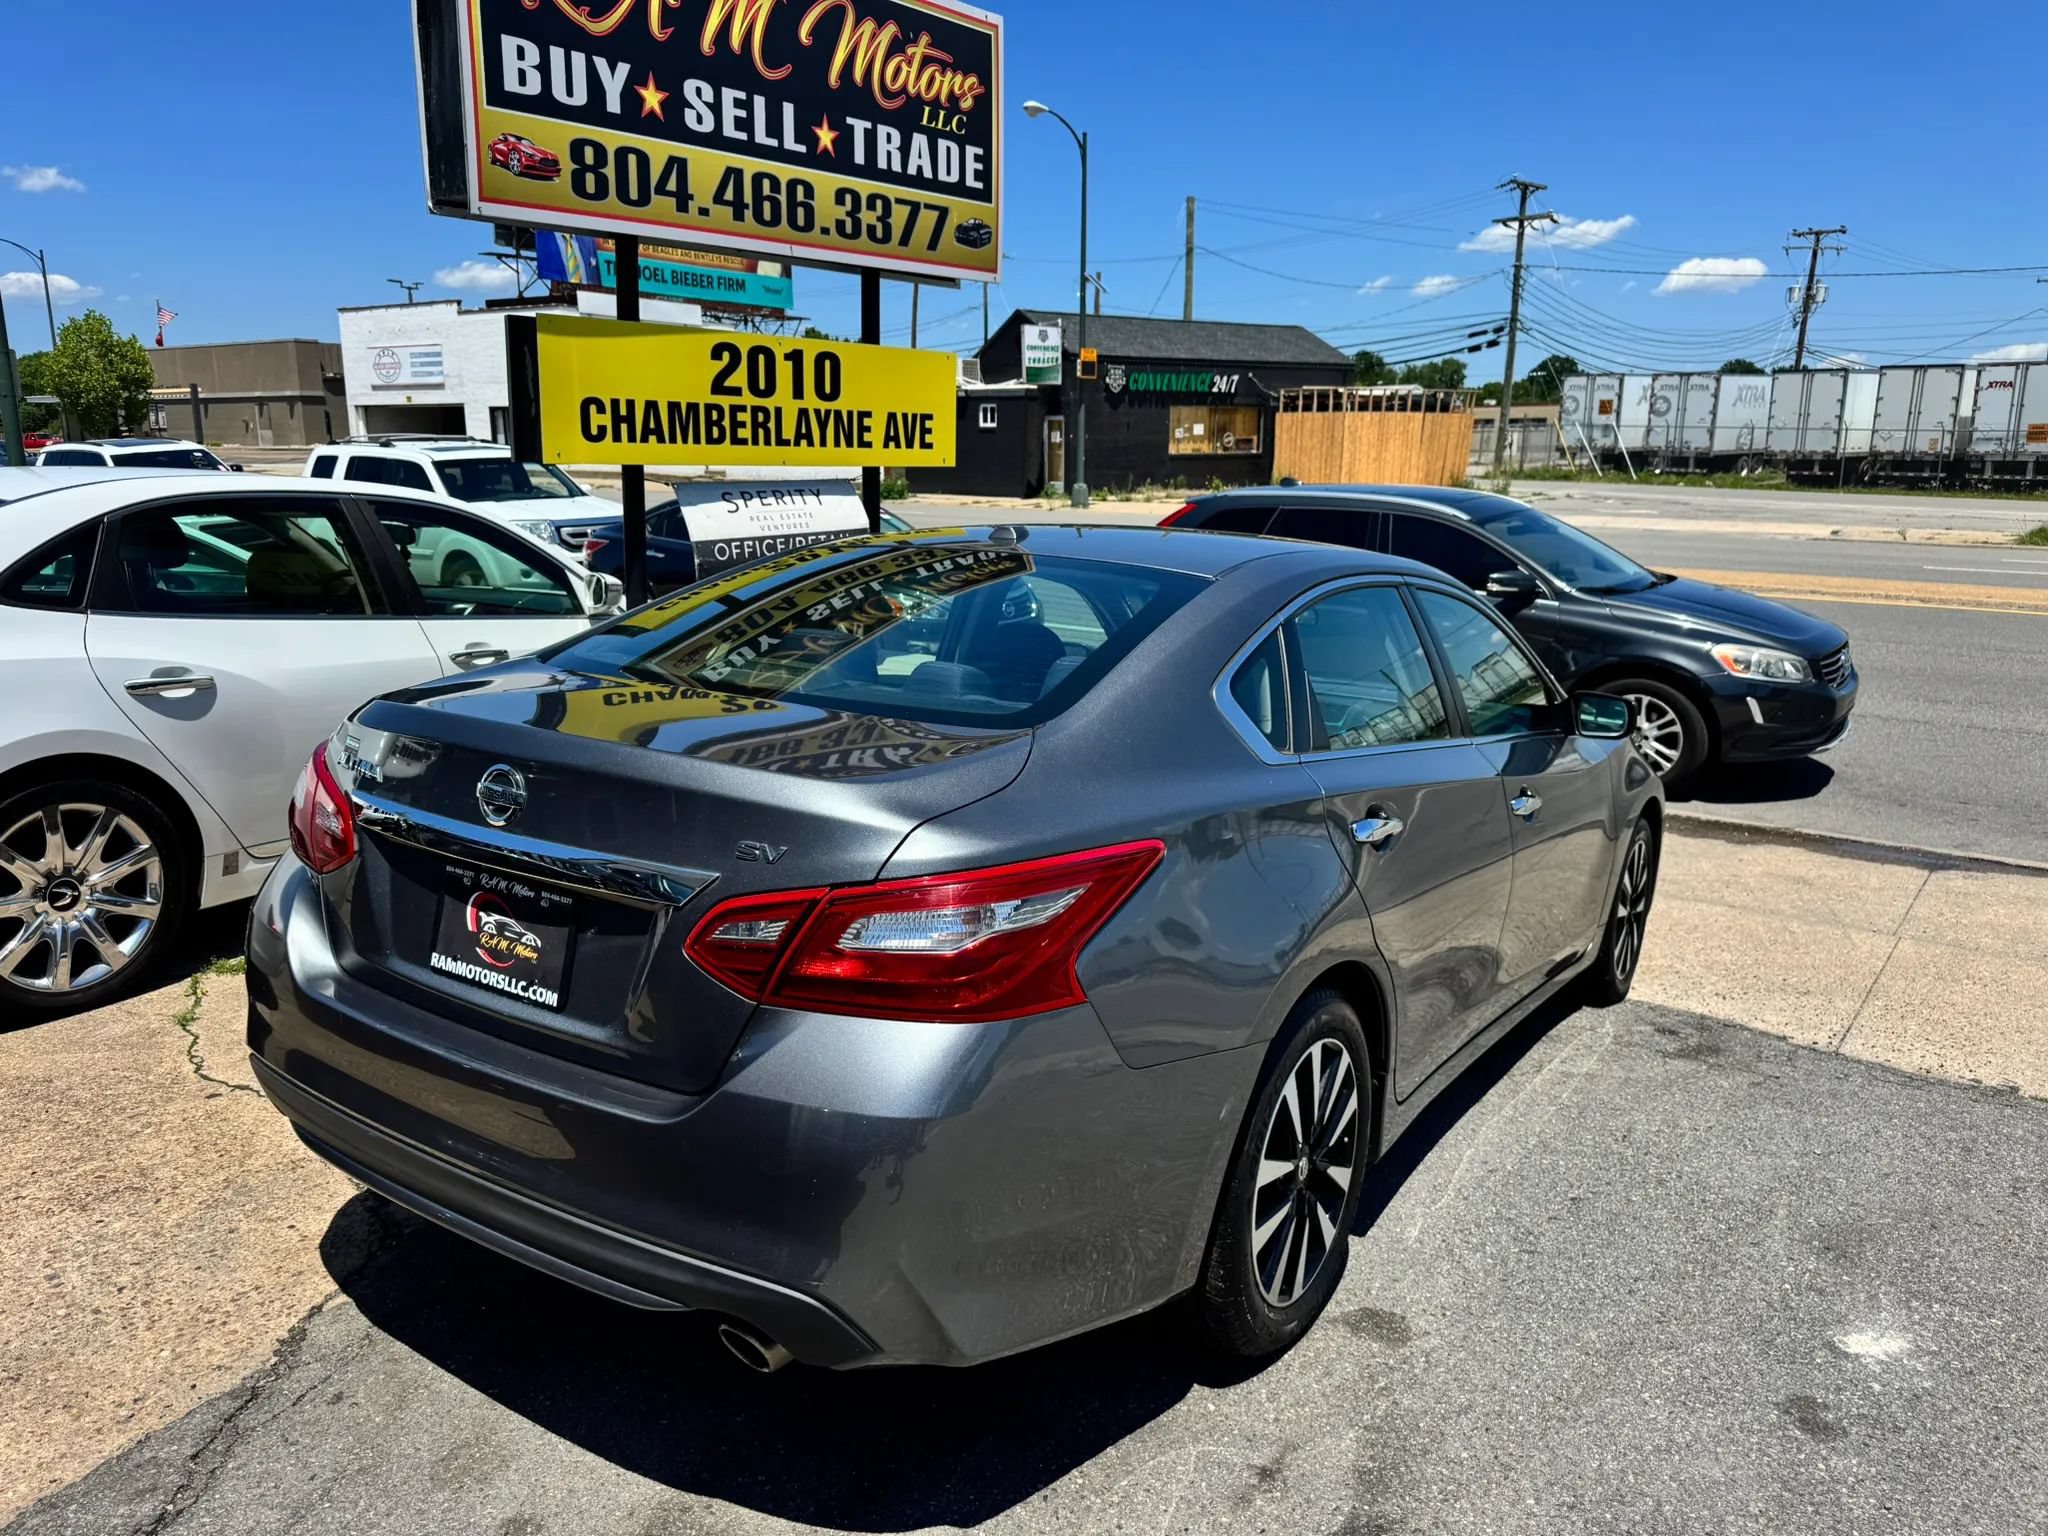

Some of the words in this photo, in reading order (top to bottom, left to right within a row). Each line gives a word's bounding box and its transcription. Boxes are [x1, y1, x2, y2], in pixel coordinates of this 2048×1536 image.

[798, 0, 985, 110] Motors
[500, 33, 631, 115] BUY
[683, 78, 807, 153] SELL
[845, 116, 984, 190] TRADE
[920, 104, 967, 135] LLC
[569, 137, 950, 252] 804.466.3377
[652, 245, 679, 257] BEAGLES
[681, 249, 692, 258] AND
[694, 251, 721, 262] BENTLEYS
[723, 255, 745, 266] RESCUE
[671, 269, 714, 290] BIEBER
[717, 275, 746, 293] FIRM
[1026, 344, 1060, 353] CONVENIENCE
[710, 341, 842, 403] 2010
[1028, 356, 1059, 365] TOBACCO
[1129, 371, 1215, 393] CONVENIENCE
[1211, 374, 1240, 394] 24/7
[1984, 380, 2014, 391] XTRA
[1732, 384, 1766, 407] XTRA
[579, 396, 873, 449] CHAMBERLAYNE
[883, 411, 934, 451] AVE
[721, 488, 823, 514] SPERITY
[760, 522, 810, 532] VENTURES
[780, 512, 814, 520] ESTATE
[714, 533, 849, 561] OFFICE/R
[480, 784, 525, 806] NISSAN
[736, 840, 789, 865] SV
[508, 880, 535, 898] Motors
[510, 941, 538, 959] Motors
[430, 952, 559, 1007] RAMMOTORSLLC.COM
